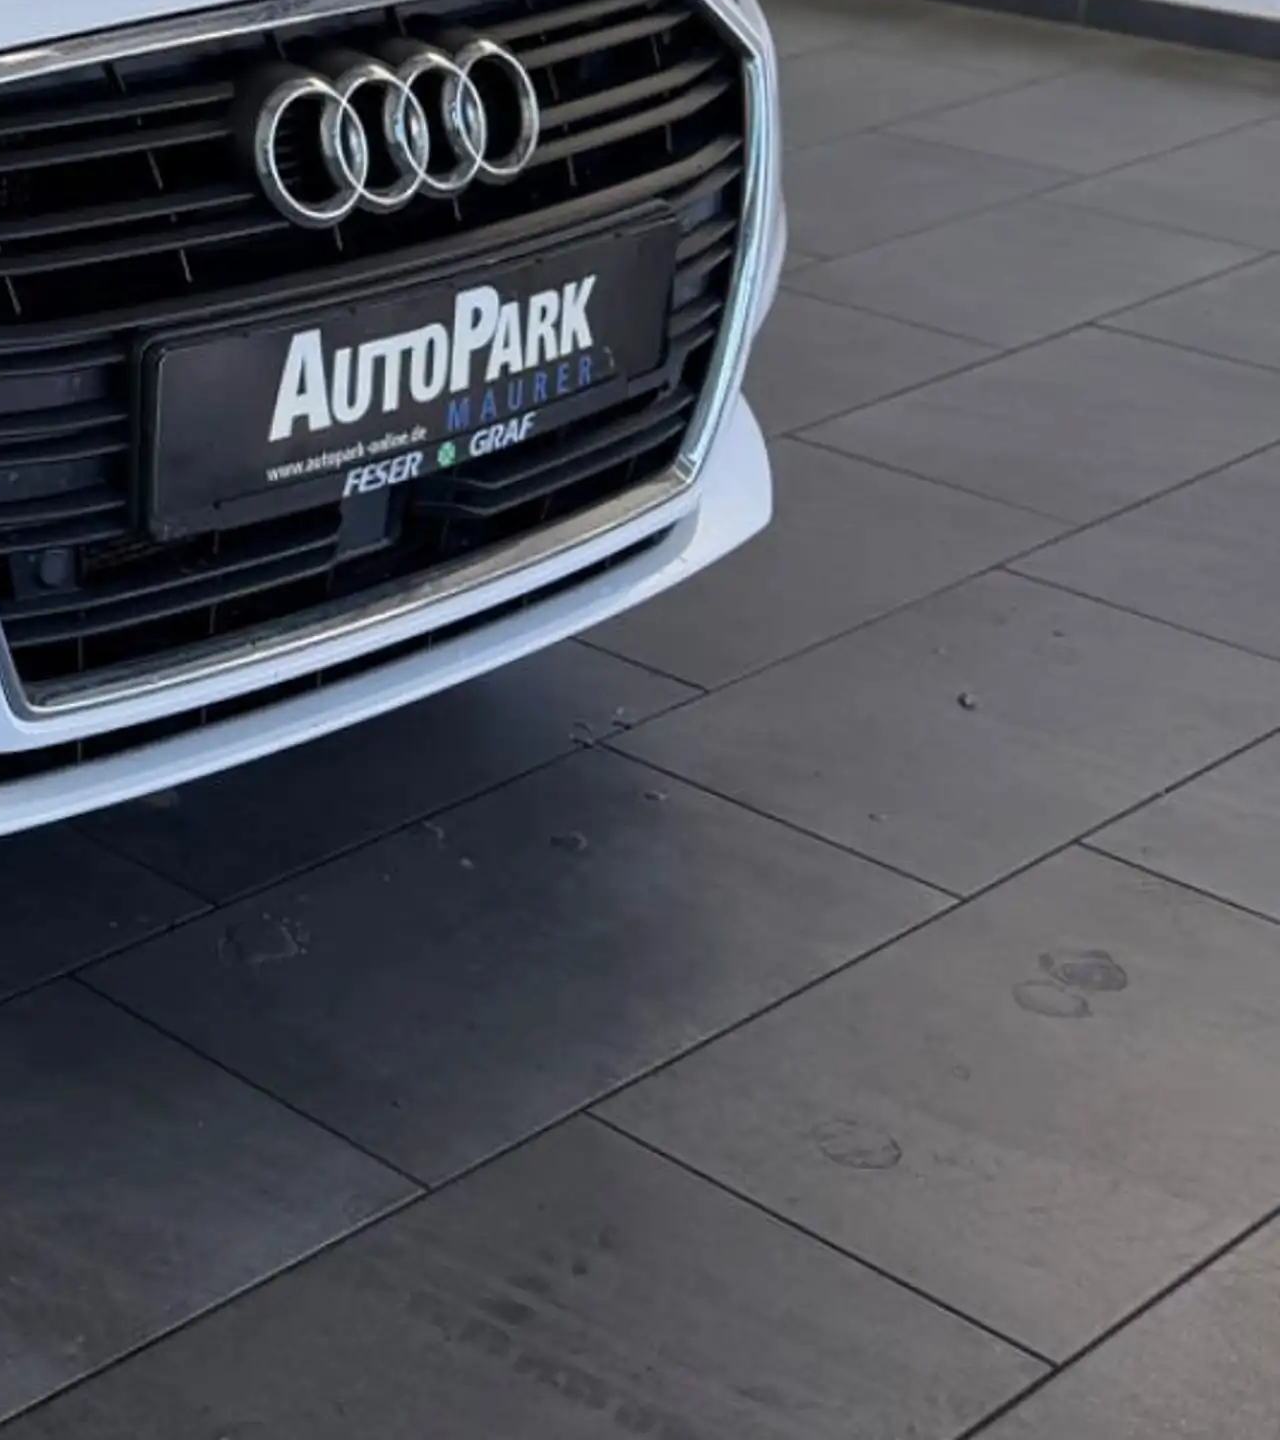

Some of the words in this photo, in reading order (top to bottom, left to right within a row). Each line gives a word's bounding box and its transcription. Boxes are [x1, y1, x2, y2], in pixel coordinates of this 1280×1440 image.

[447, 355, 592, 431] MAURER
[266, 424, 427, 482] www.autopark-online.de
[342, 451, 423, 498] FESER
[469, 411, 537, 457] GRAF
